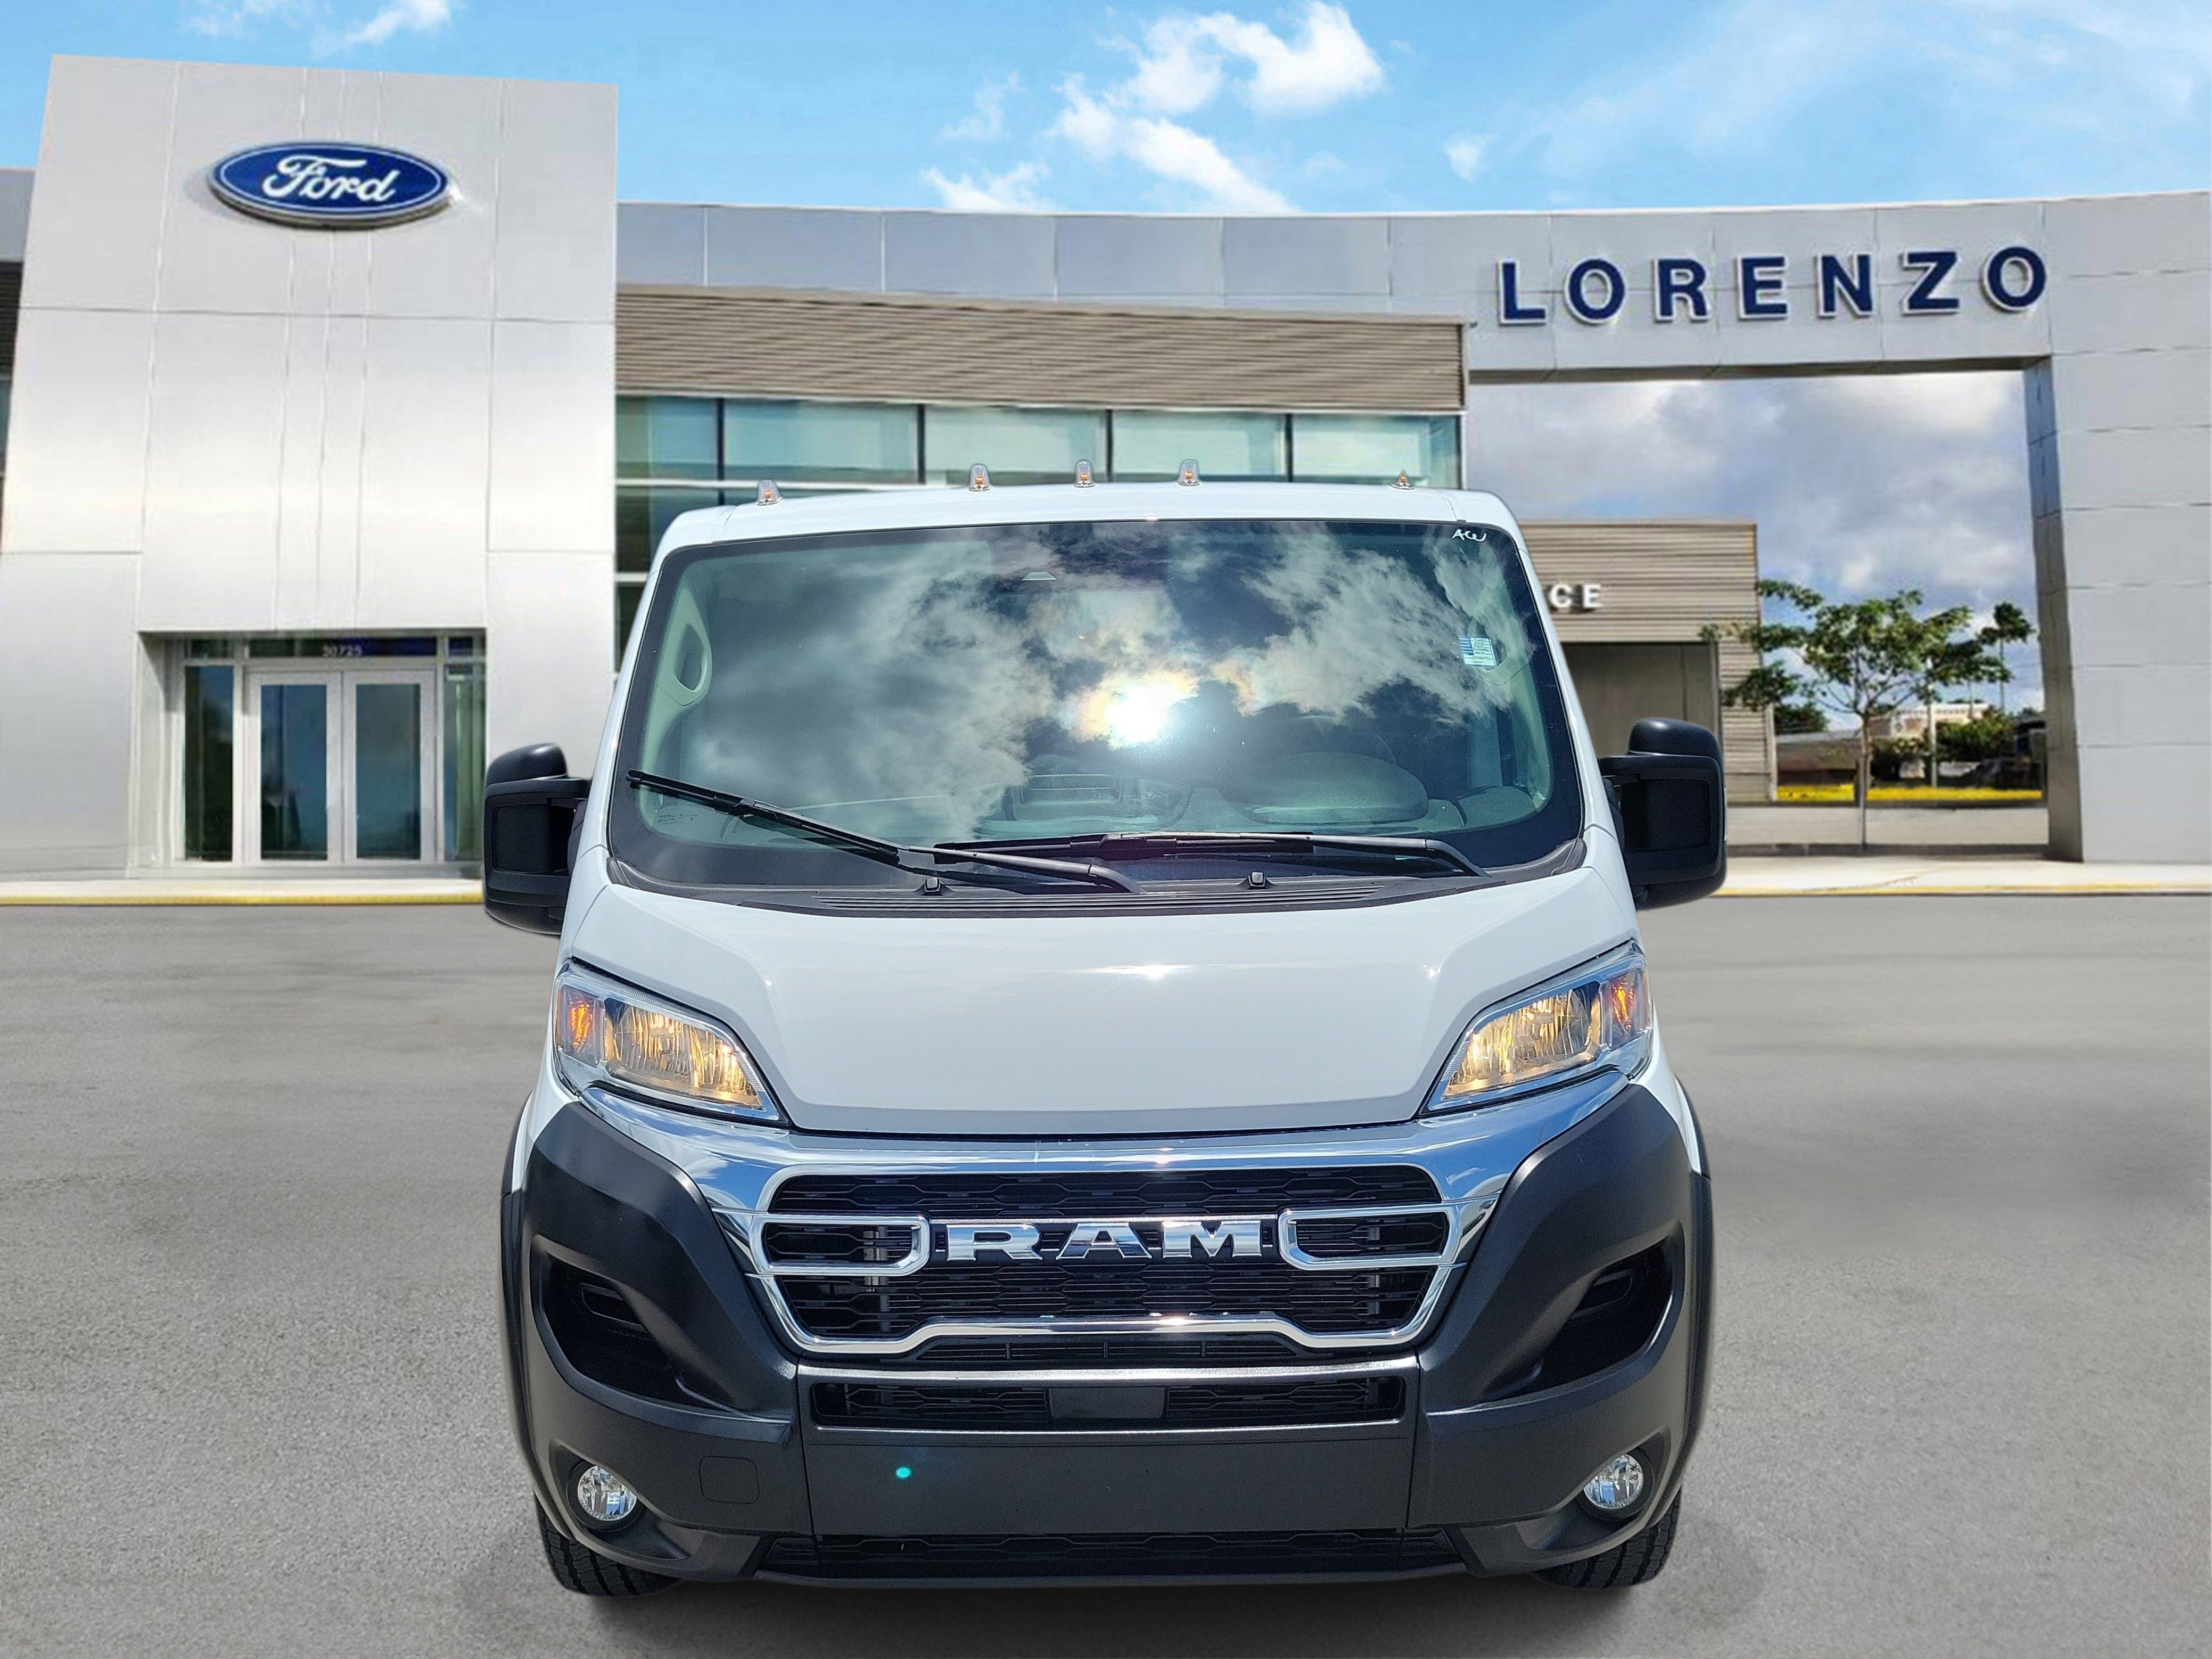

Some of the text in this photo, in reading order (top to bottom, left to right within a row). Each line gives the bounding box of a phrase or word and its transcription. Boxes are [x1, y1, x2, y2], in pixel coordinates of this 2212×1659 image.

[261, 155, 400, 202] Ford
[1498, 247, 2046, 325] LORENZO
[947, 1221, 1262, 1261] RAM
